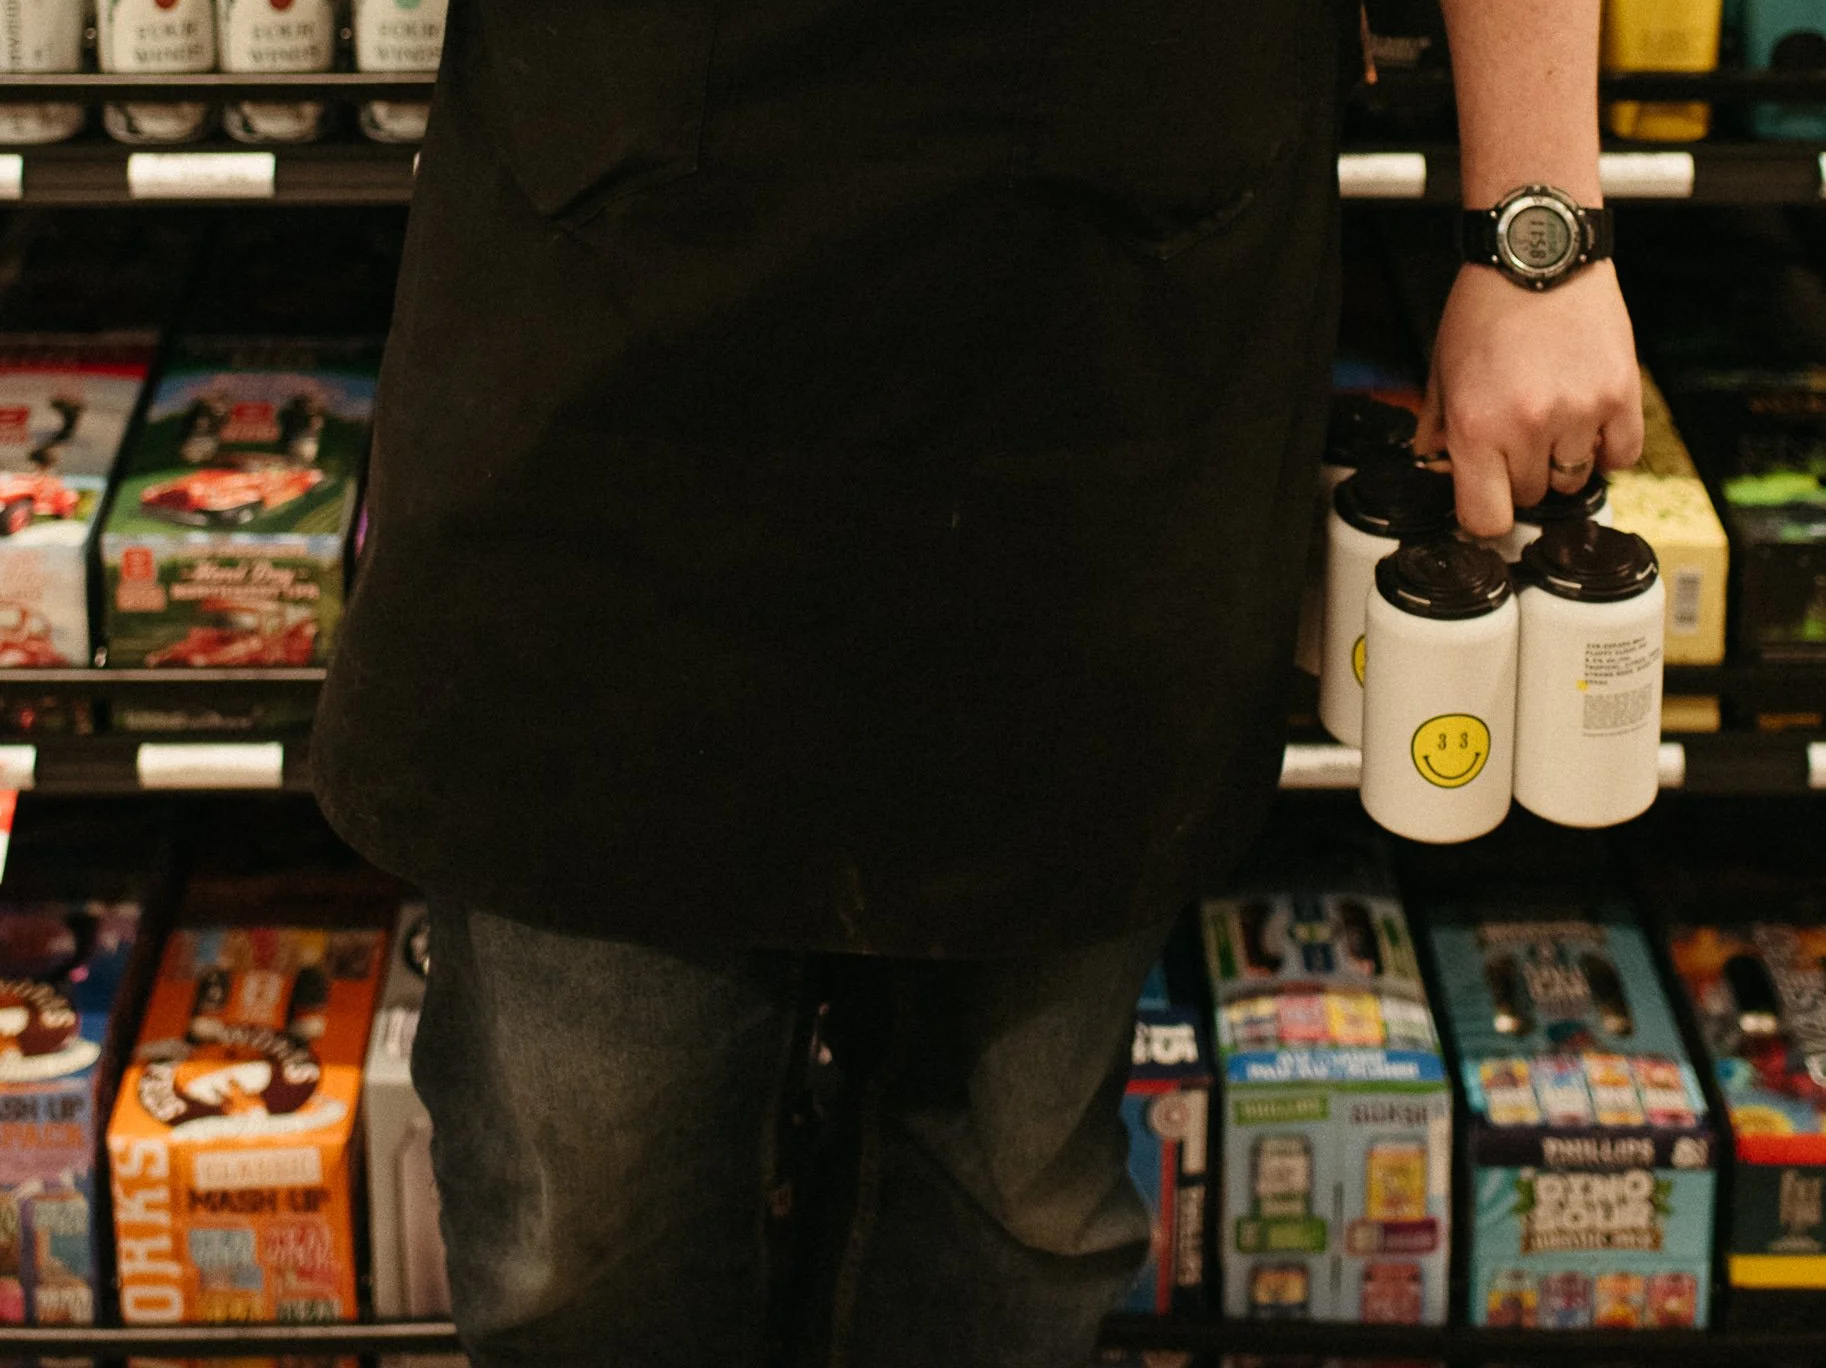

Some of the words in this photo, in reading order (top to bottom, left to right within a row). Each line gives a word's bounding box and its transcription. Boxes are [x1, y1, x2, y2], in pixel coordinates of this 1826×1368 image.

[1543, 1136, 1656, 1166] PHILLIPS
[188, 1188, 278, 1214] MASH
[285, 1188, 331, 1214] UP
